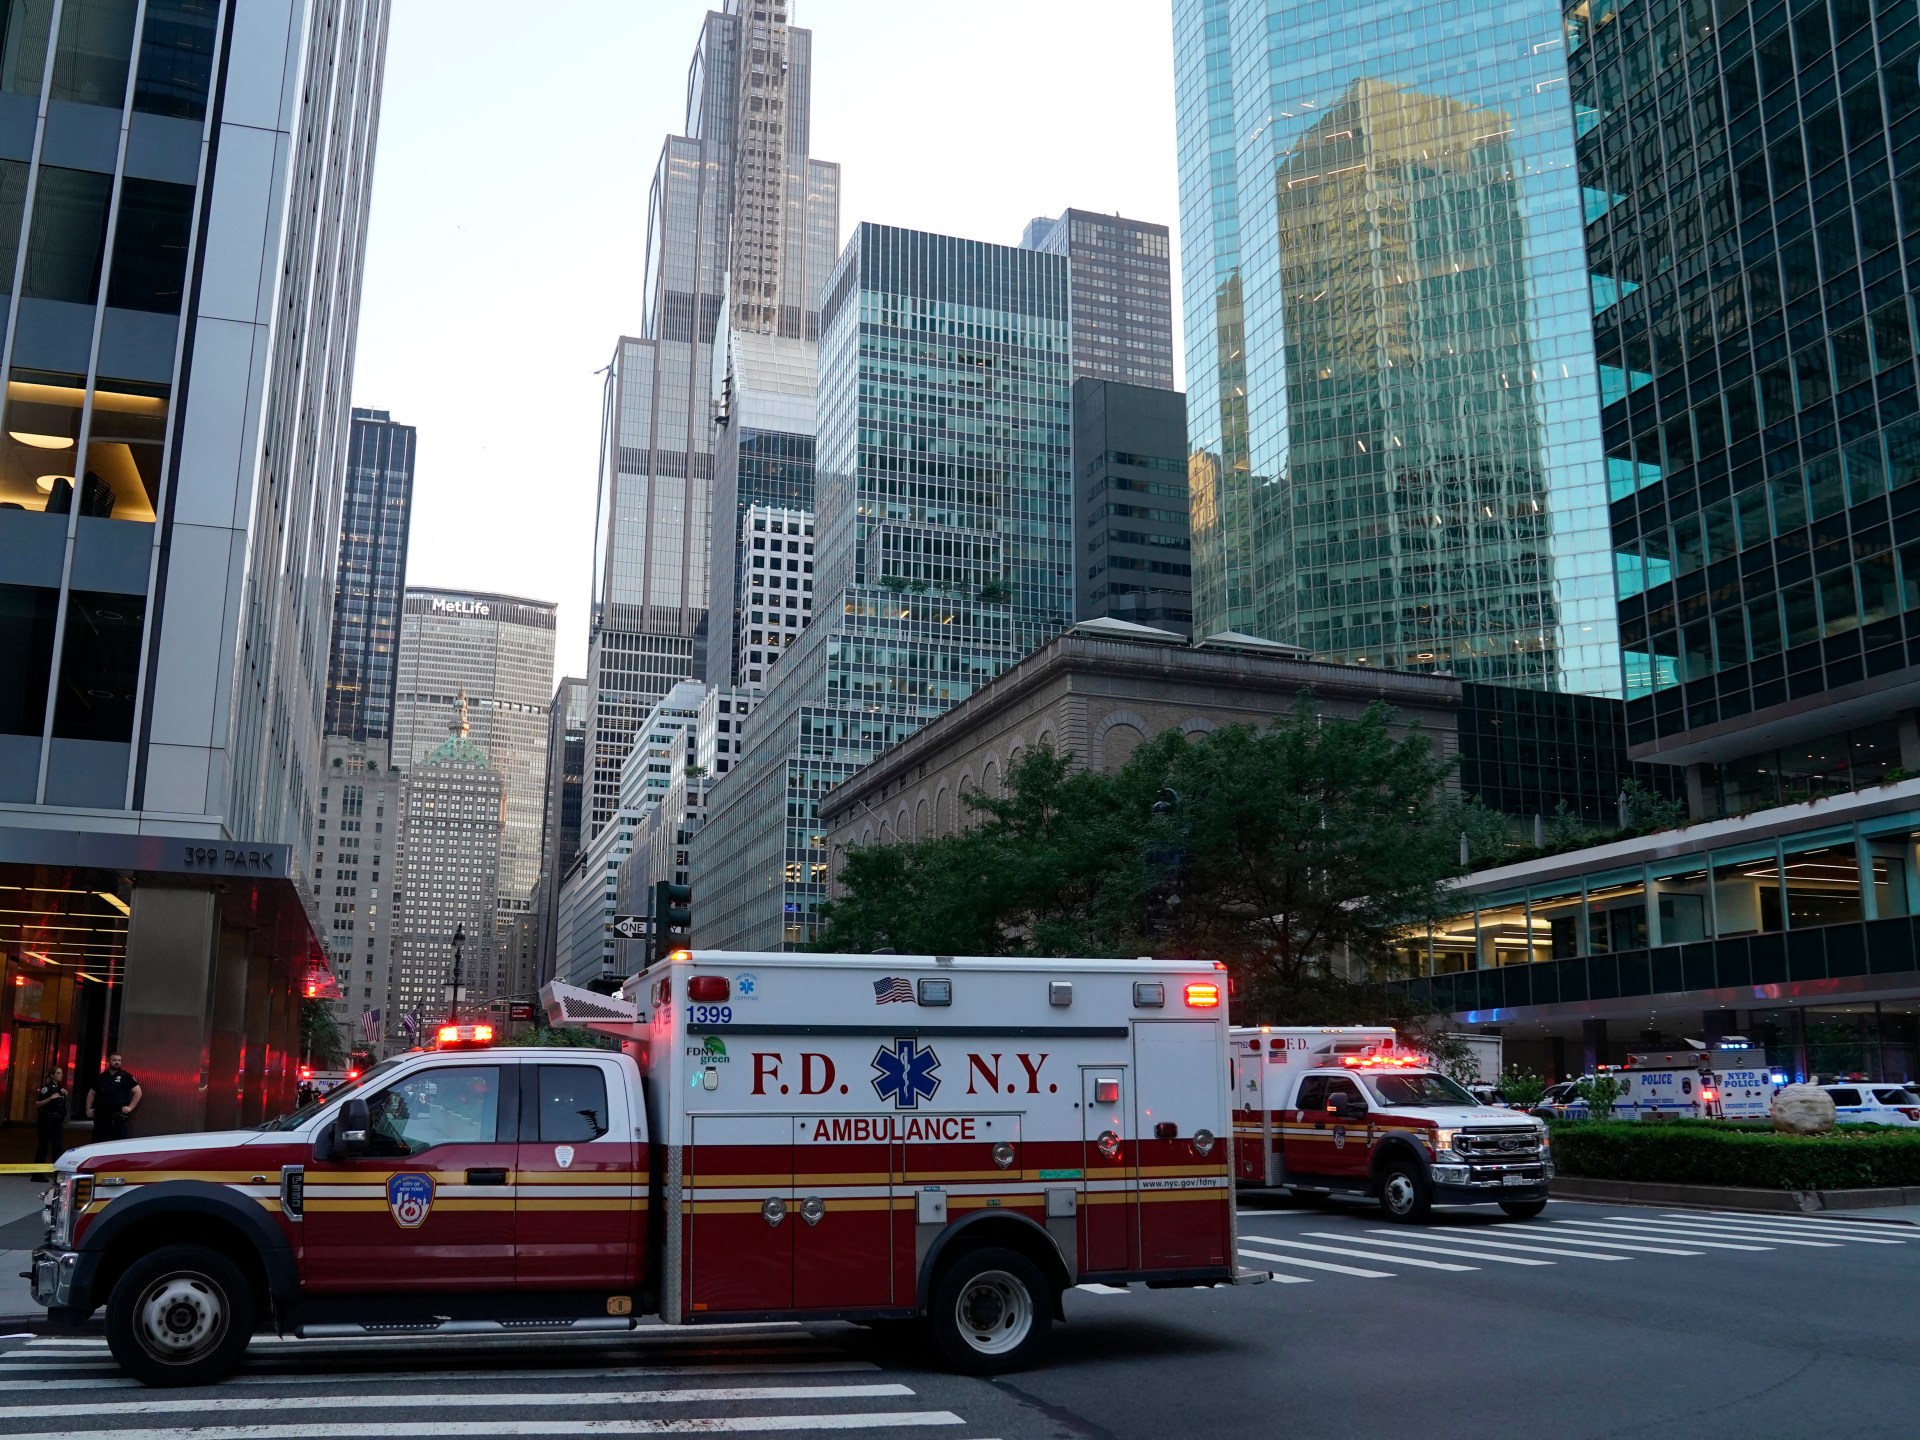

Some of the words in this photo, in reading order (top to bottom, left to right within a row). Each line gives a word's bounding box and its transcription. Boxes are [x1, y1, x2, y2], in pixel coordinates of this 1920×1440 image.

[432, 599, 489, 615] MetLife
[184, 846, 218, 864] 399
[225, 849, 274, 870] PARK
[621, 922, 644, 933] ONE
[686, 1005, 732, 1024] 1399
[686, 1047, 716, 1056] FDNY
[700, 1055, 730, 1065] green
[1641, 1073, 1673, 1085] POLICE
[1727, 1072, 1755, 1080] NYPD
[1724, 1079, 1760, 1088] POLICE
[1565, 1109, 1589, 1120] NYPD
[812, 1117, 976, 1142] AMBULANCE
[402, 1176, 430, 1187] DEPARTMENT
[1142, 1178, 1217, 1188] www.nyc.gov/fdny
